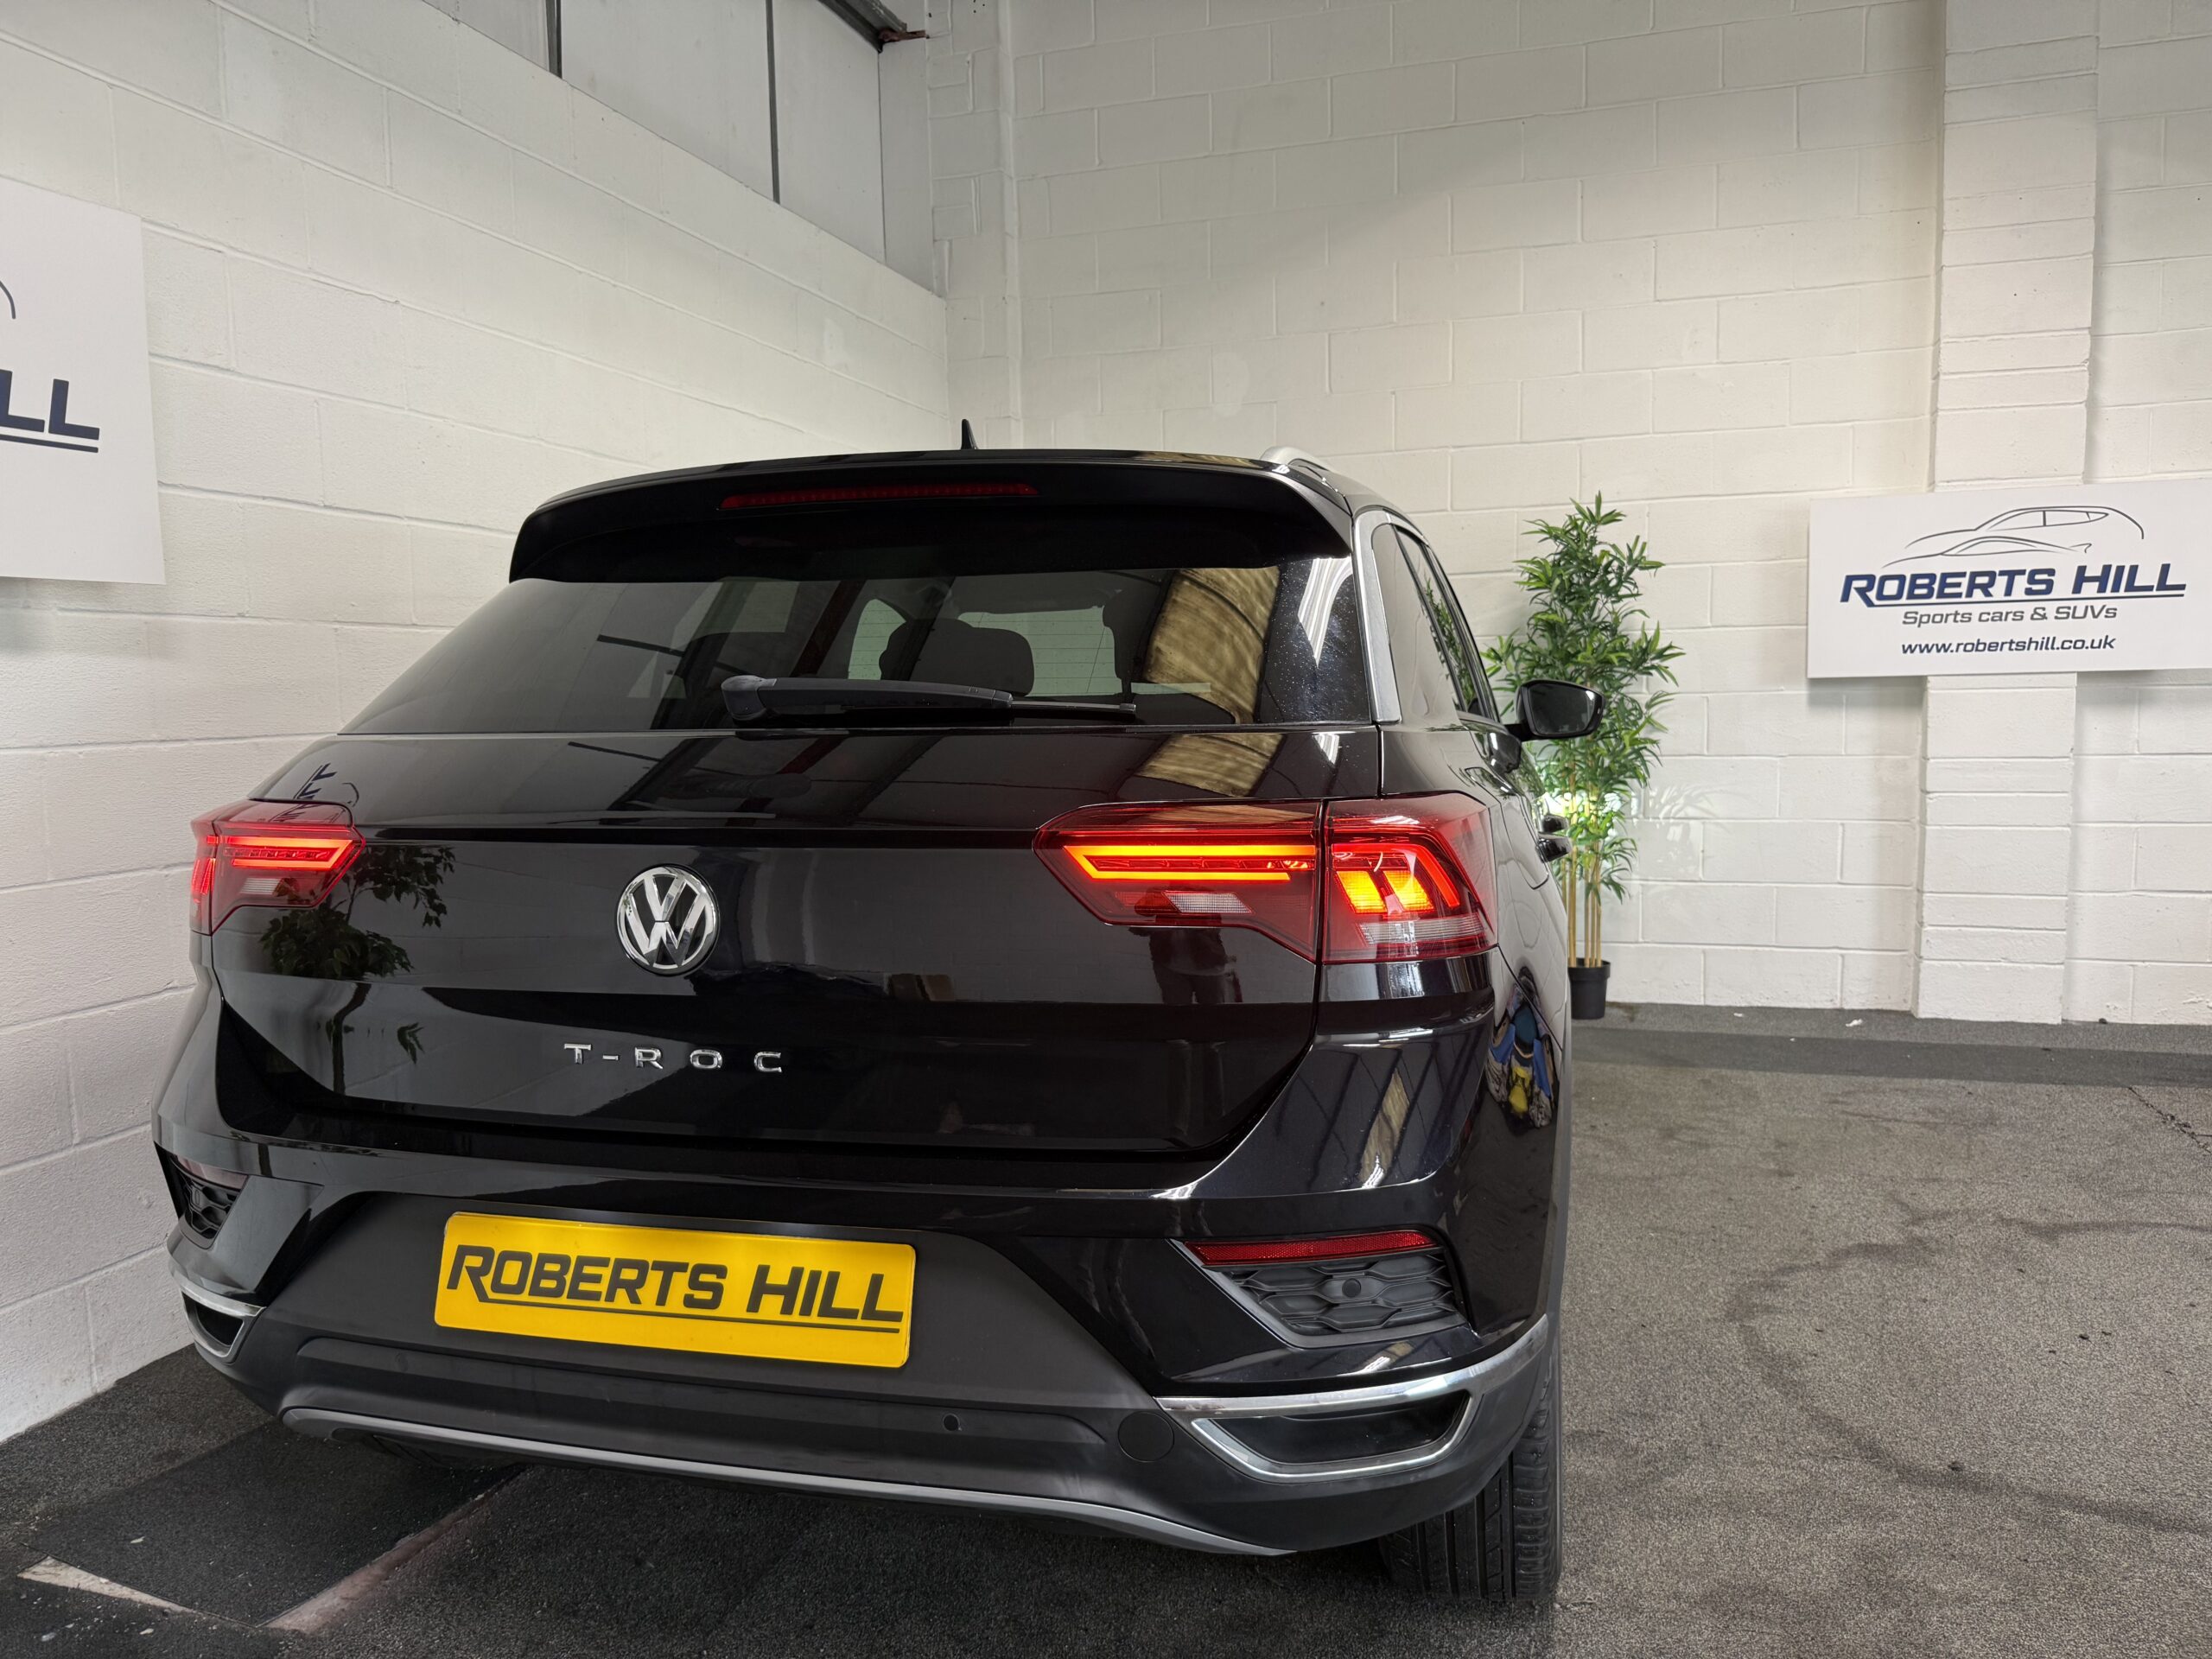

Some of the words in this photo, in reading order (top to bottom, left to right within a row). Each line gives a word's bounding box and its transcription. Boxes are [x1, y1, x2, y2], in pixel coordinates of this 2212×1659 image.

[1840, 567, 2056, 607] ROBERTS
[2071, 563, 2187, 594] HILL
[1902, 610, 1972, 627] Sports
[1978, 608, 2024, 623] cars
[2030, 607, 2048, 620] &
[2054, 605, 2118, 620] SUVs
[1901, 635, 2116, 654] www.robertshill.co.uk
[564, 1043, 783, 1072] T-ROC
[446, 1244, 728, 1311] ROBERTS
[746, 1264, 904, 1323] HILL
